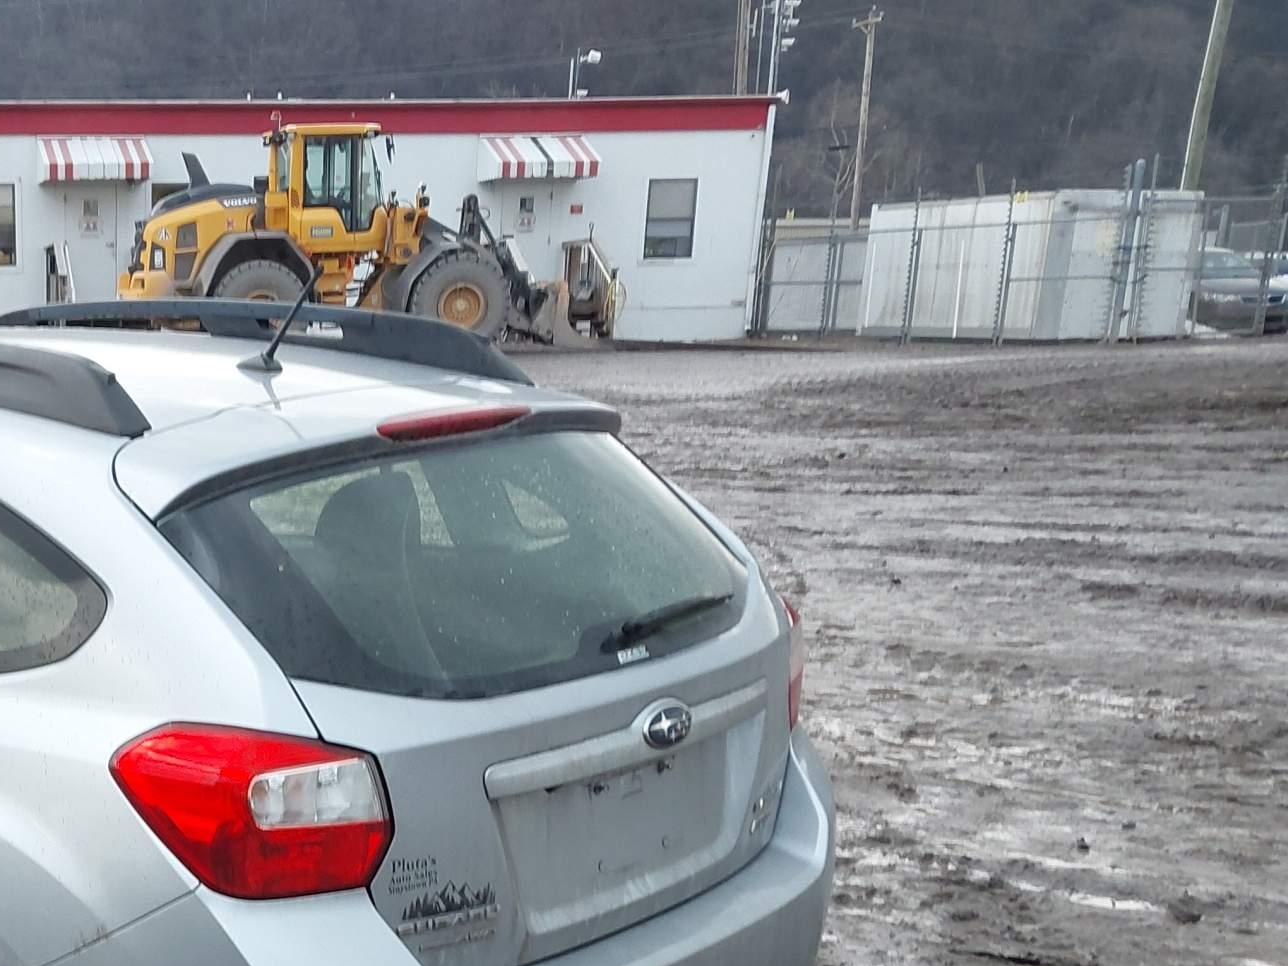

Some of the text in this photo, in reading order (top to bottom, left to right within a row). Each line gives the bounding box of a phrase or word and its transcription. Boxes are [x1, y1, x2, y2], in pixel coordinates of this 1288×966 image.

[223, 196, 257, 208] VOLVO
[391, 855, 437, 874] Pluta's
[390, 868, 438, 885] Auto Sales
